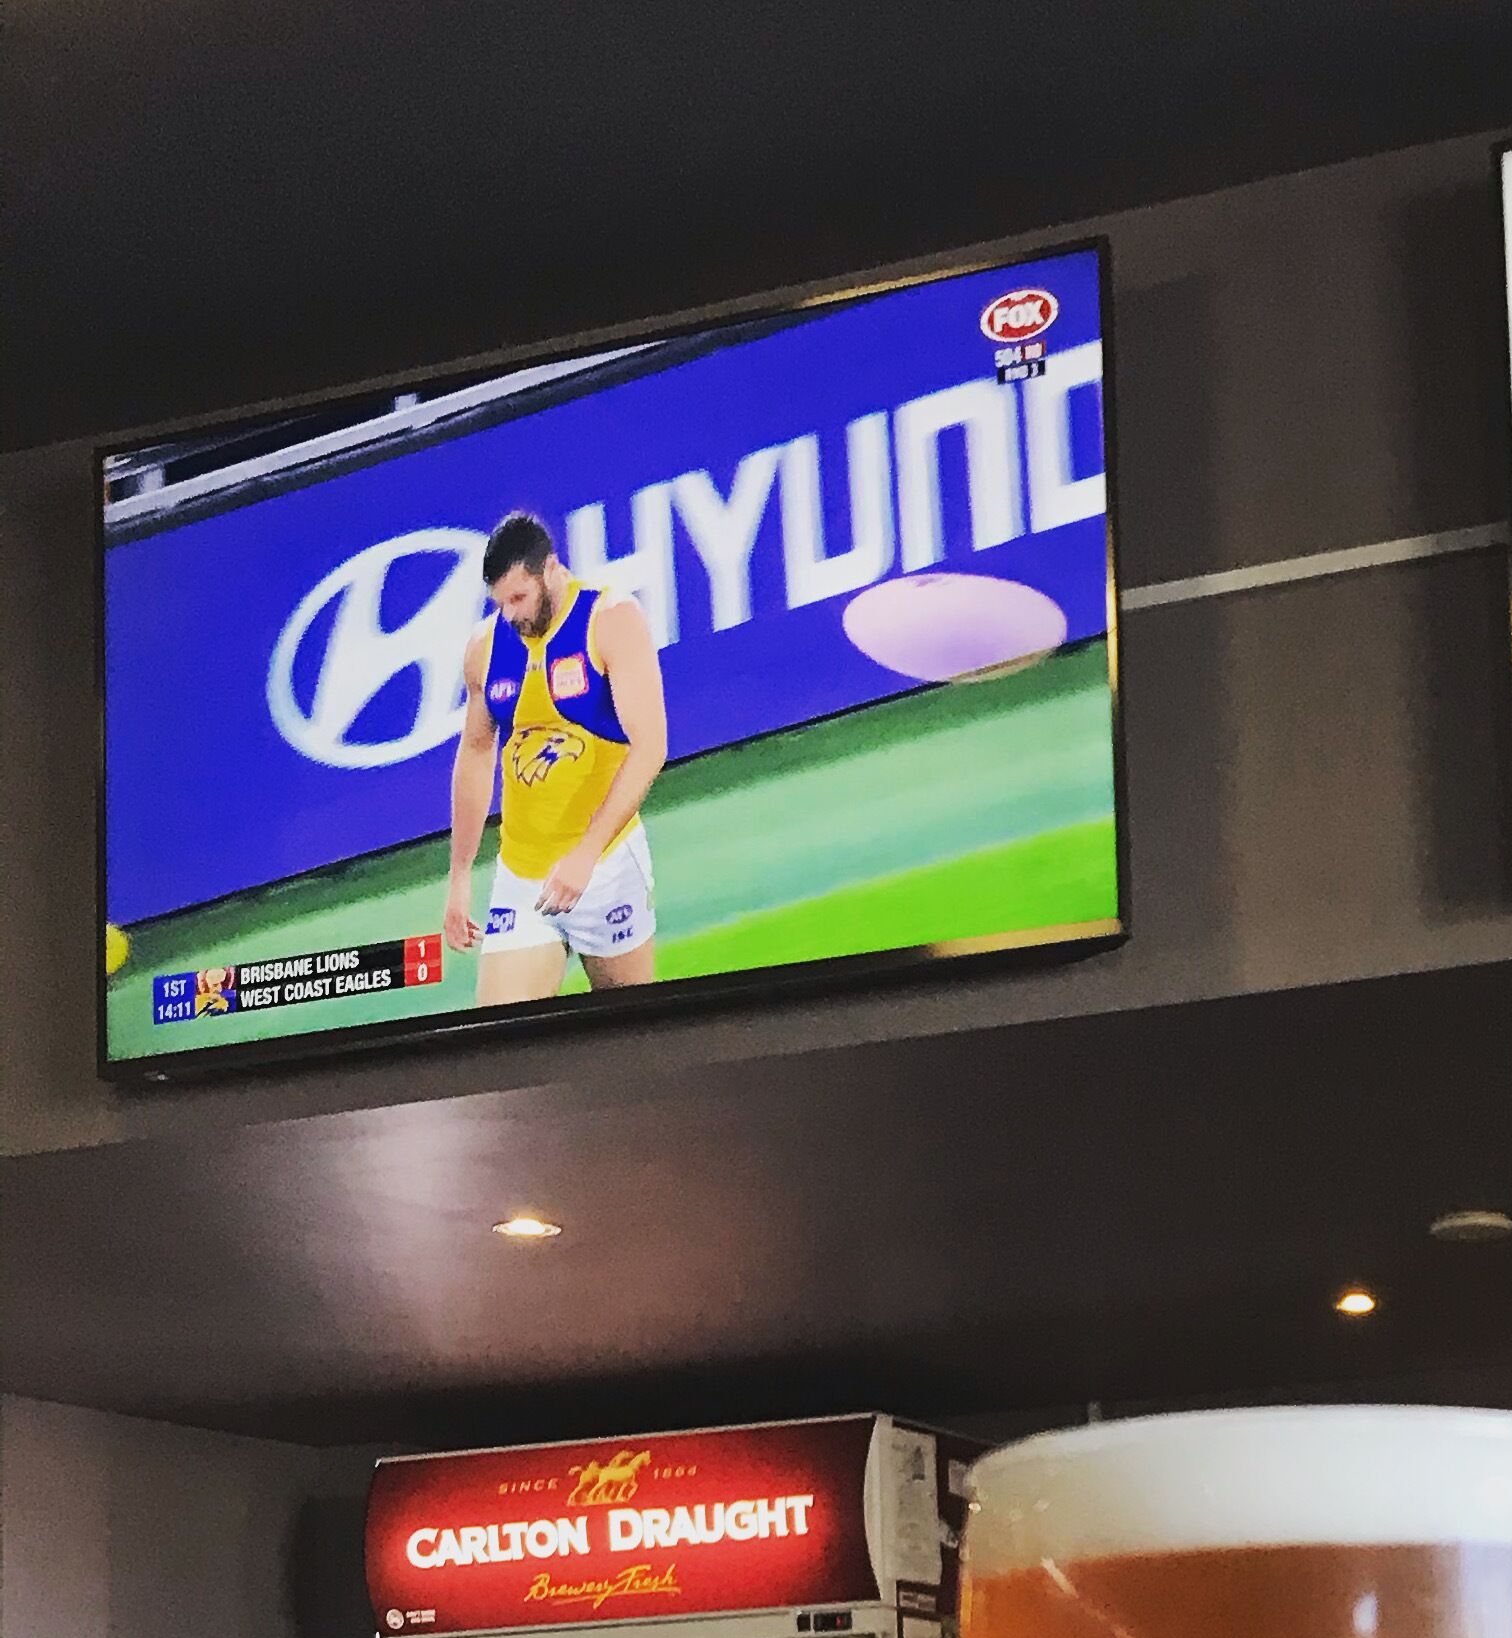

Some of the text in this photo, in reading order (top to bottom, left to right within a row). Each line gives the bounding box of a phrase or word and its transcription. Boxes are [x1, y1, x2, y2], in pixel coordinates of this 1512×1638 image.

[994, 300, 1045, 332] FOX
[240, 940, 425, 985] BRISBANE LIONS 1
[164, 980, 186, 997] 1ST
[240, 964, 427, 1008] WEST COAST EAGLES 0
[158, 1002, 191, 1020] 14:11
[499, 1478, 559, 1495] SINCE
[406, 1495, 814, 1568] CARLTON DRAUGHT
[524, 1564, 678, 1609] Brewery Fresh
